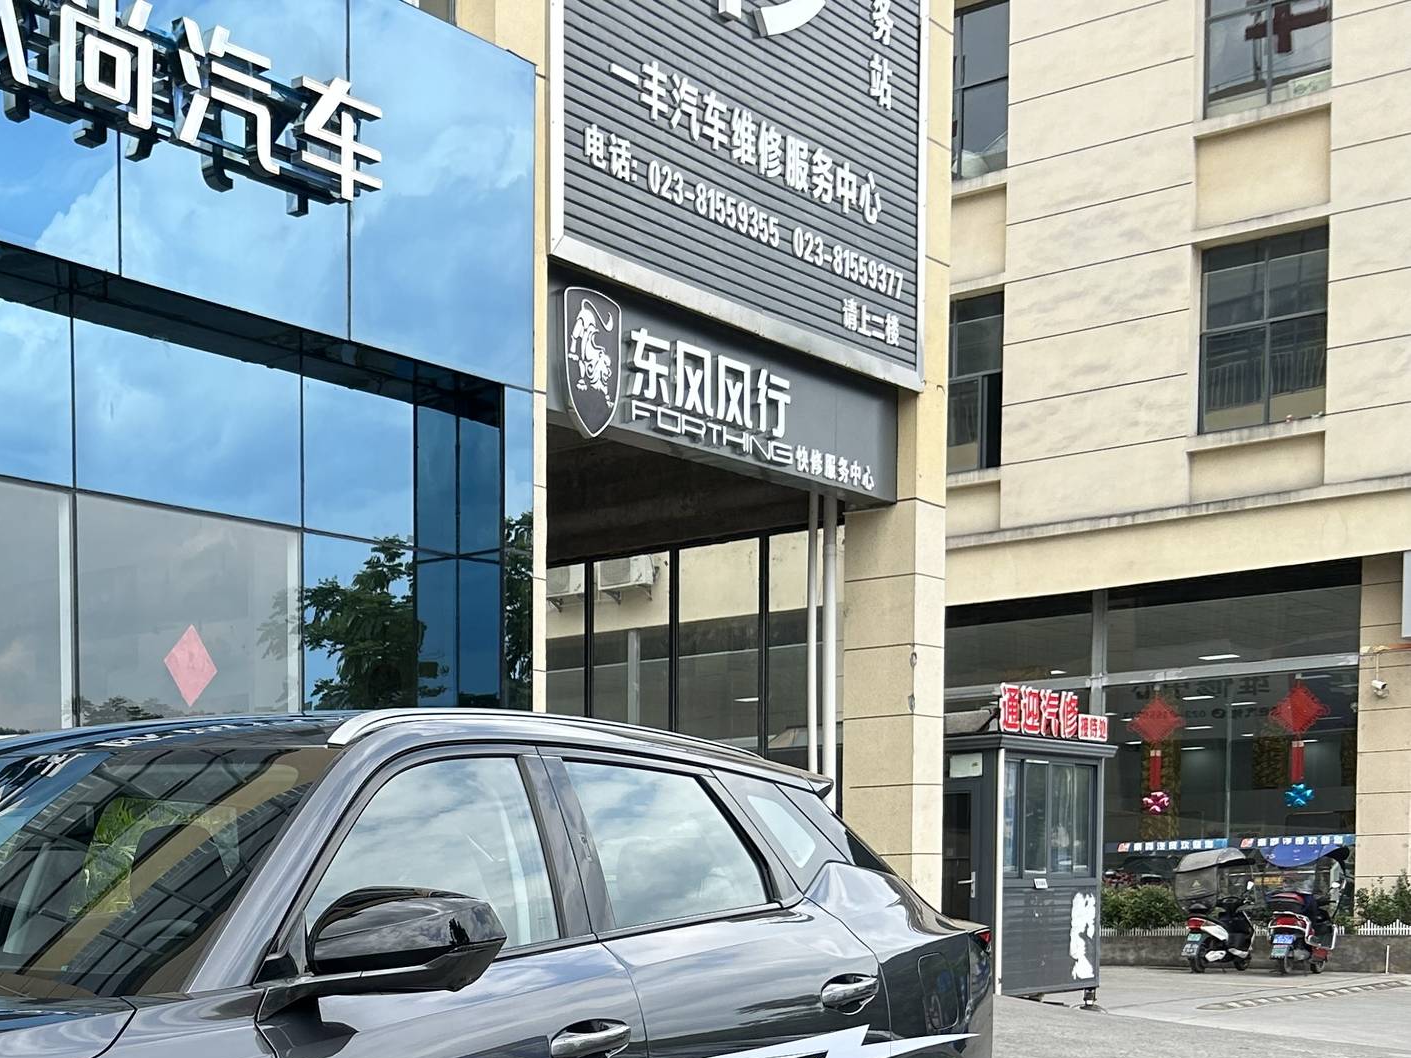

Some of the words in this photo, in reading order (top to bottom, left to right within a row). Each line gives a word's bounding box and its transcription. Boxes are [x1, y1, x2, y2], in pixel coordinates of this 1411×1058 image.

[610, 61, 882, 224] 一丰汽车维修服务中心
[648, 161, 780, 248] 023-81559355
[793, 227, 904, 299] 023-81559377
[842, 298, 900, 347] 请上二楼
[630, 327, 791, 438] 东风风行
[631, 400, 794, 466] FORTHING
[795, 445, 875, 491] 快修服务中心
